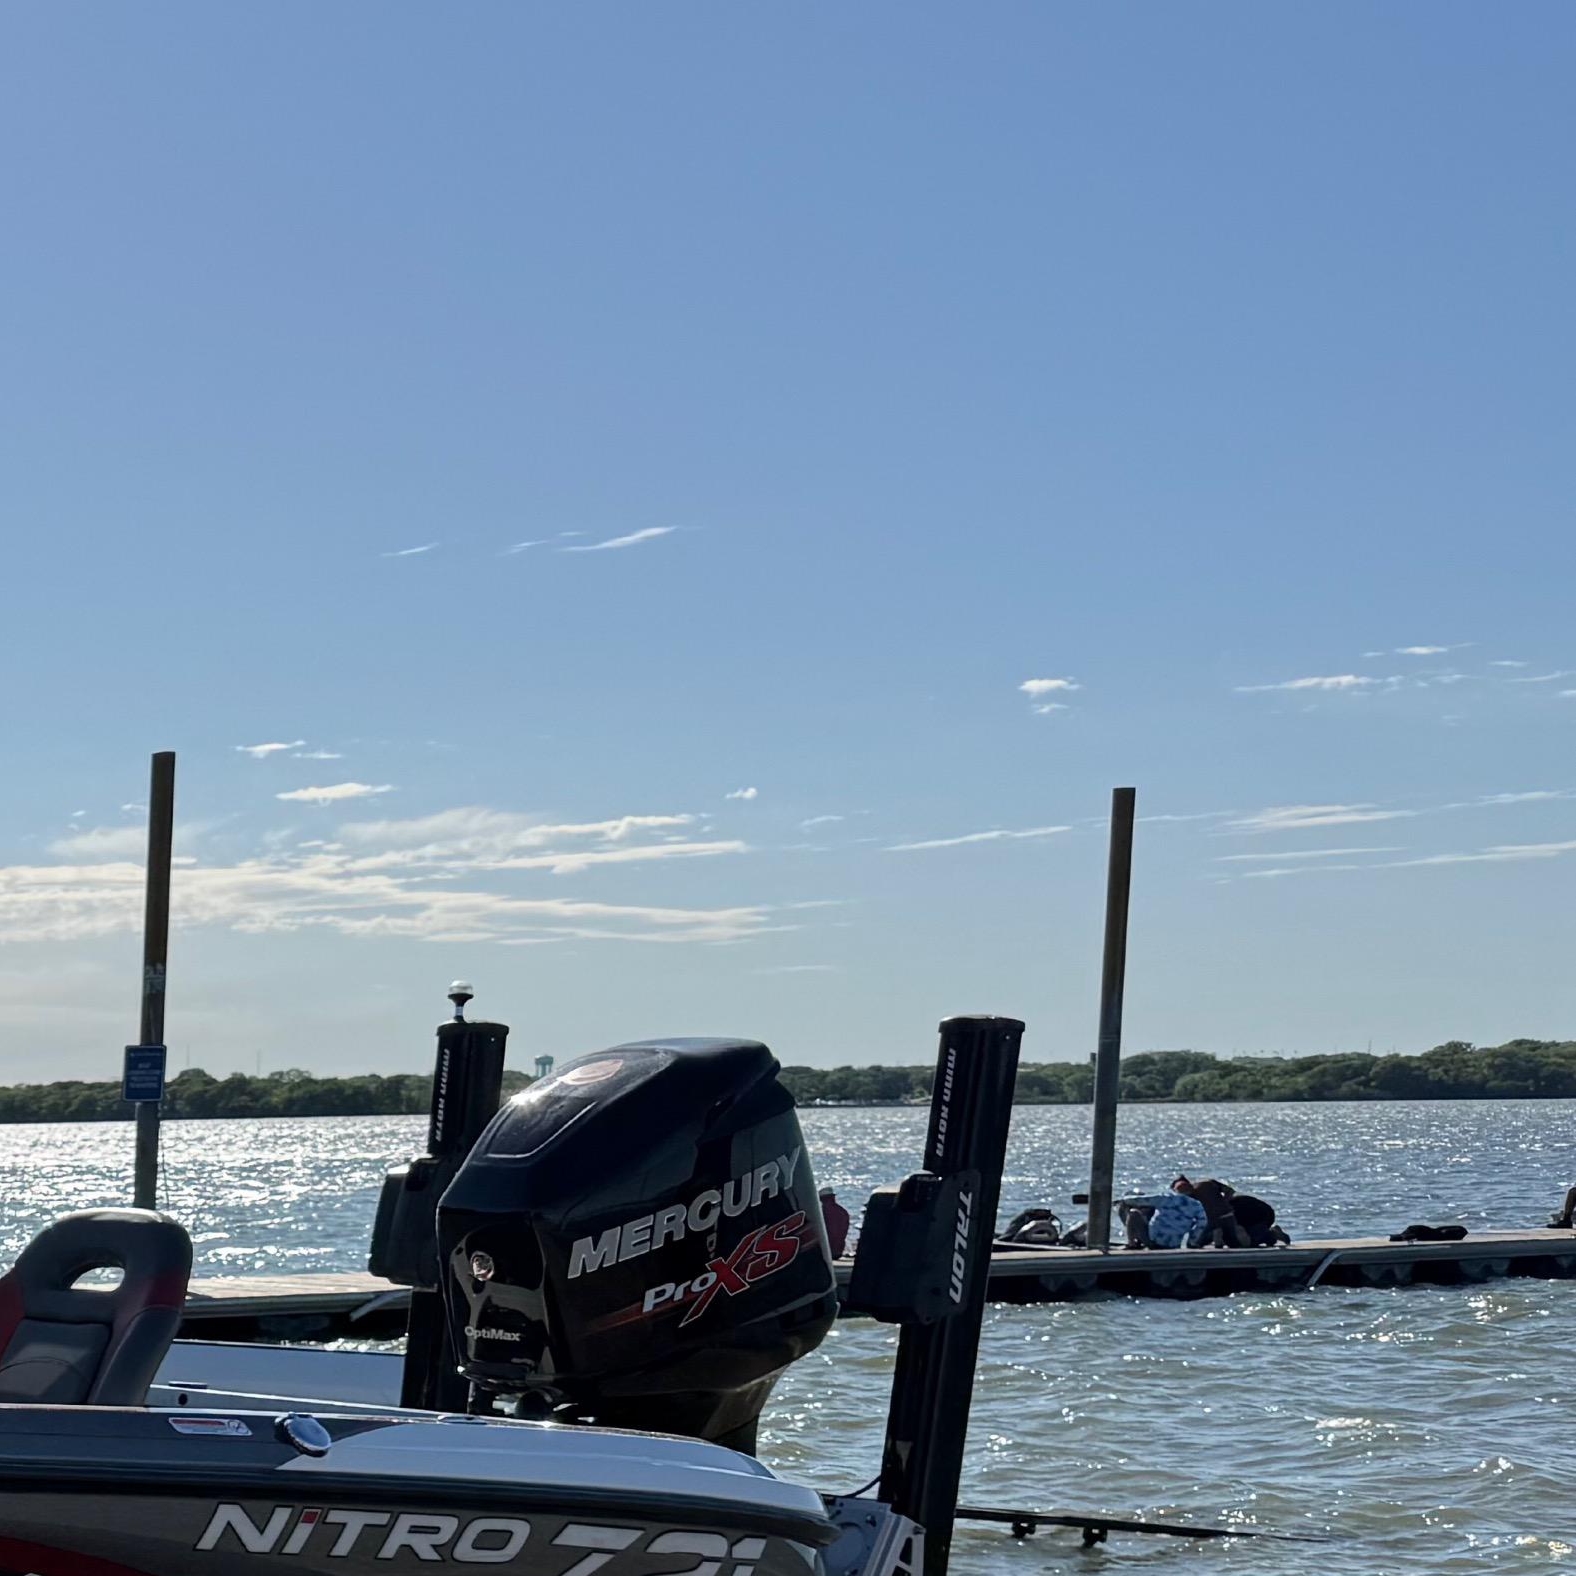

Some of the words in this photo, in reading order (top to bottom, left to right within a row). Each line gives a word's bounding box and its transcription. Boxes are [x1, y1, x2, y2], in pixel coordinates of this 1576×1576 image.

[567, 1145, 802, 1279] MERCURY
[949, 1191, 973, 1303] TALON
[464, 1325, 521, 1342] OptiMax
